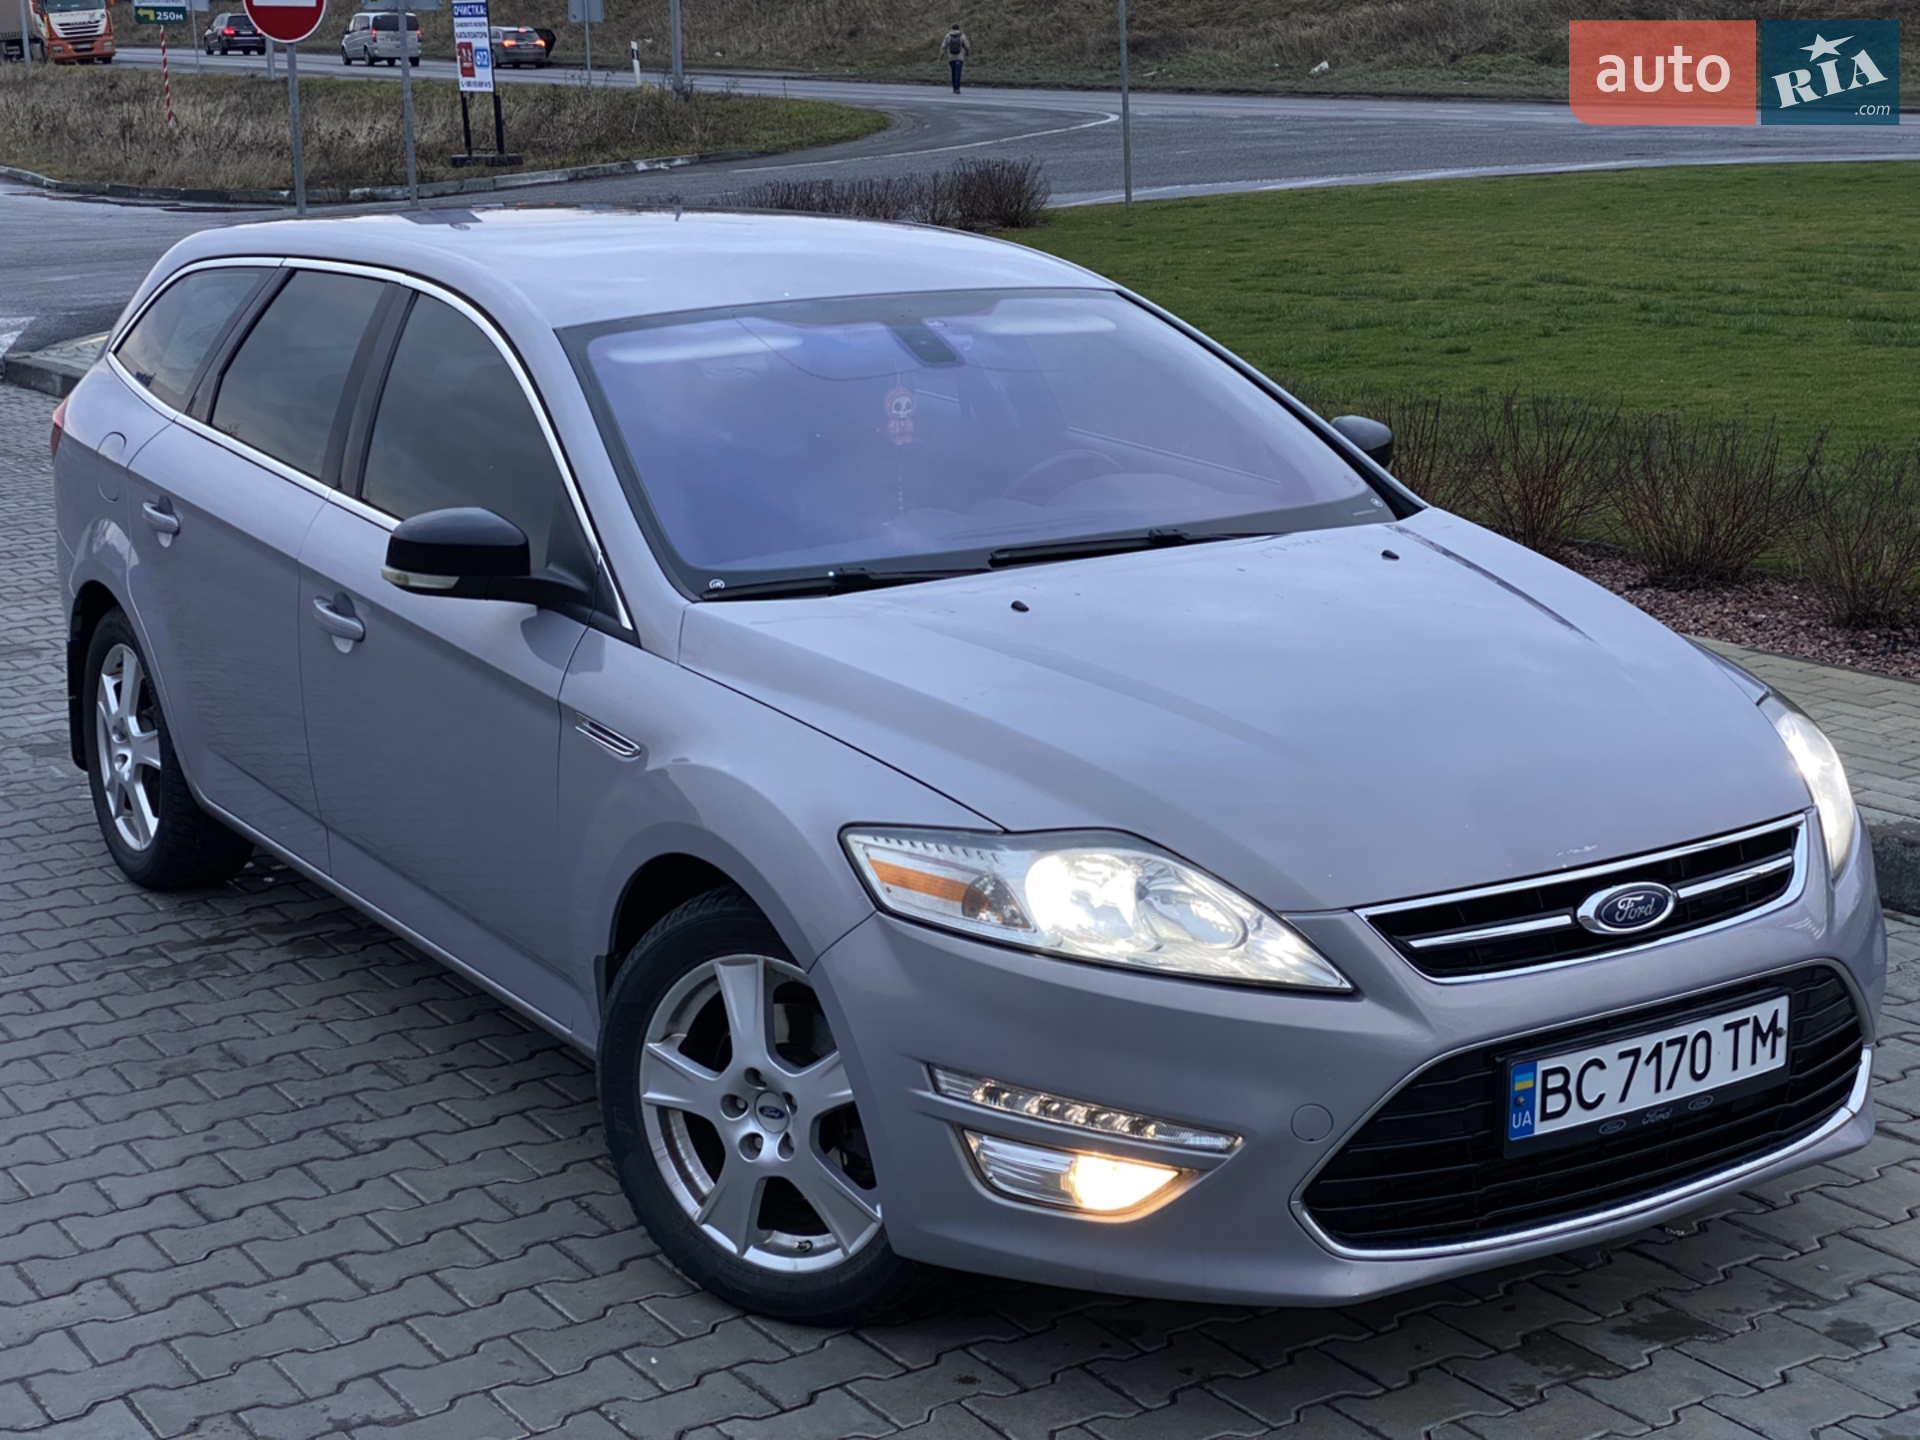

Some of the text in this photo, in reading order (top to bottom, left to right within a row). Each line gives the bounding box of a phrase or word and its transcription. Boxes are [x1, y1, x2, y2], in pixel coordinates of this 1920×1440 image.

[1615, 895, 1656, 922] Ford
[1539, 1008, 1780, 1122] BC 7170 TM
[1511, 1110, 1533, 1130] UA
[1642, 1107, 1673, 1125] Ford
